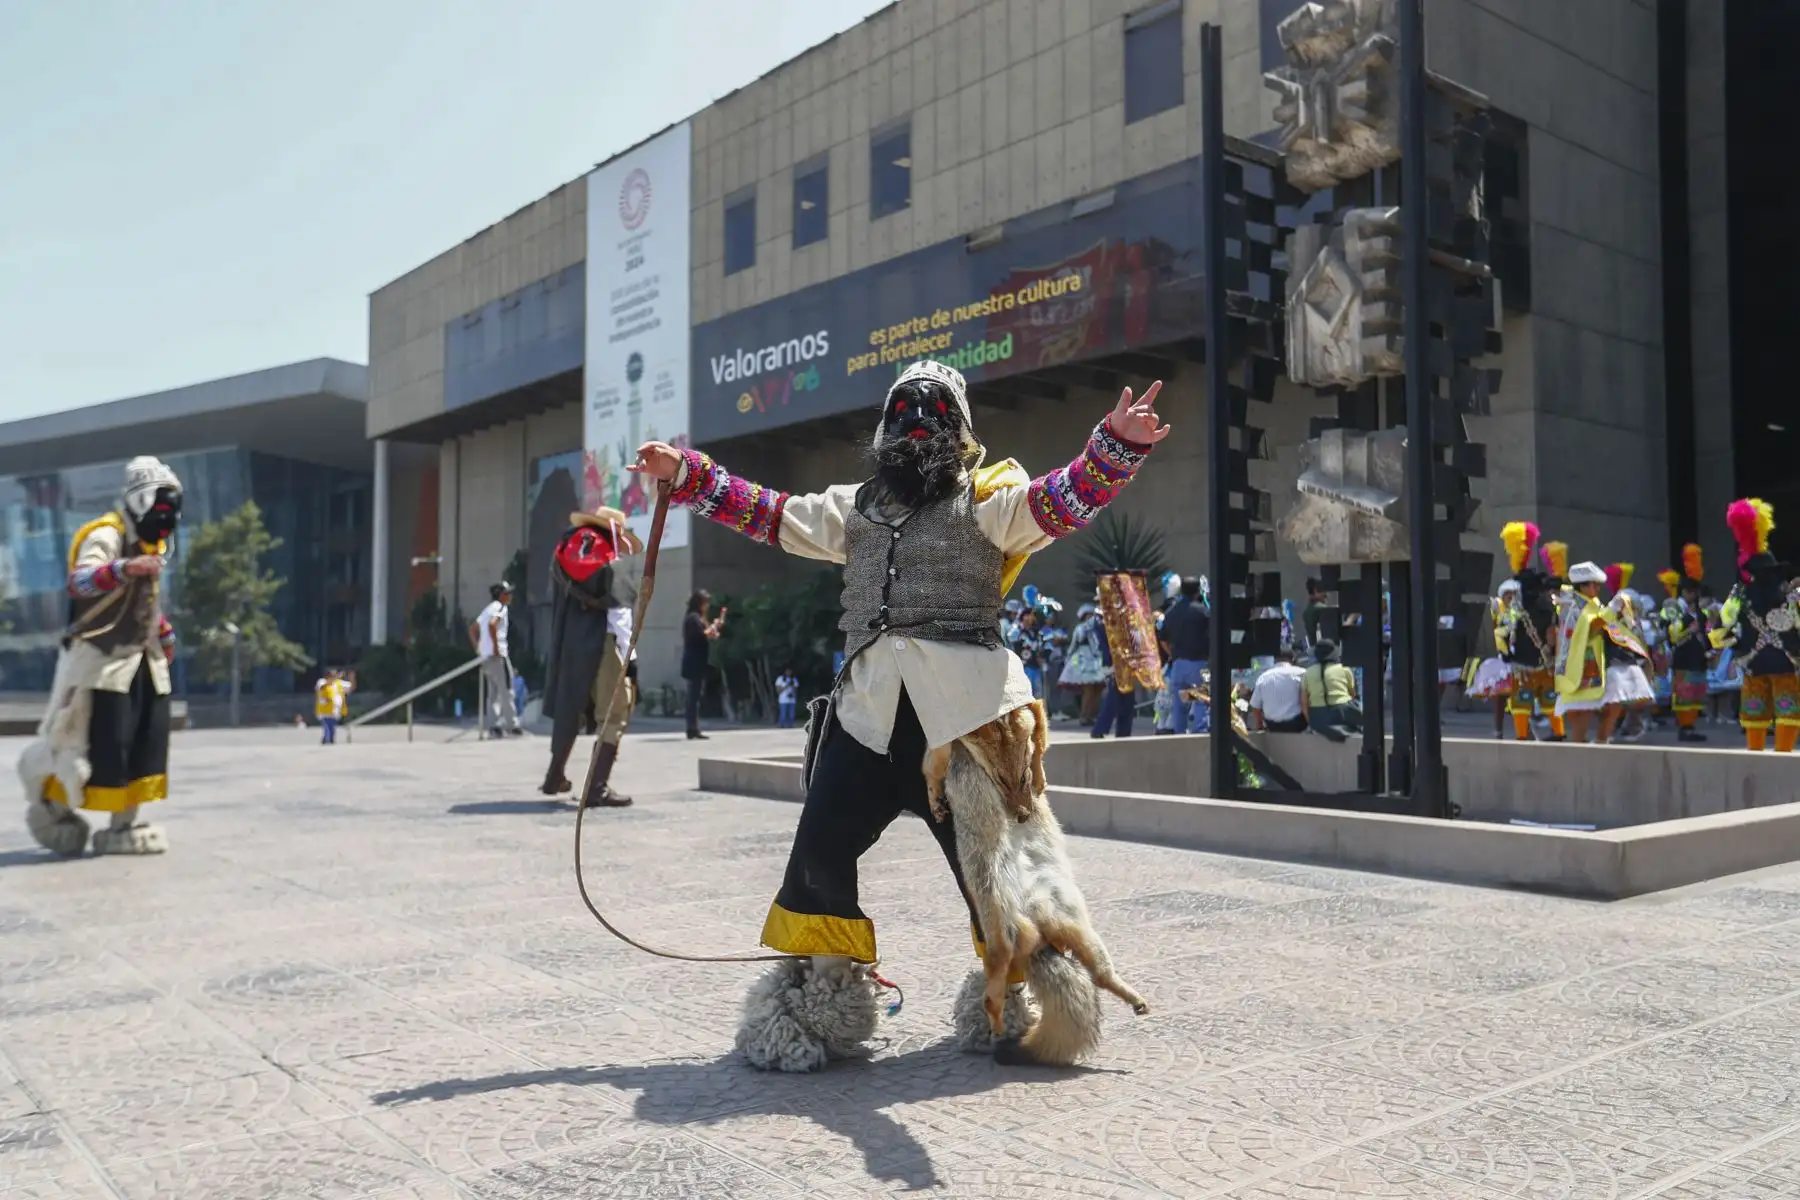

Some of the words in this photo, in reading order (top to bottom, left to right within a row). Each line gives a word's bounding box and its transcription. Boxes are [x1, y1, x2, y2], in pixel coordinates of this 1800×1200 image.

[869, 327, 887, 345] es
[888, 317, 929, 344] parte
[930, 308, 951, 329] de
[952, 293, 1014, 323] nuestra
[1017, 273, 1082, 305] cultura
[711, 329, 829, 384] Valorarnos
[847, 352, 878, 376] para
[880, 331, 954, 364] fortalecer
